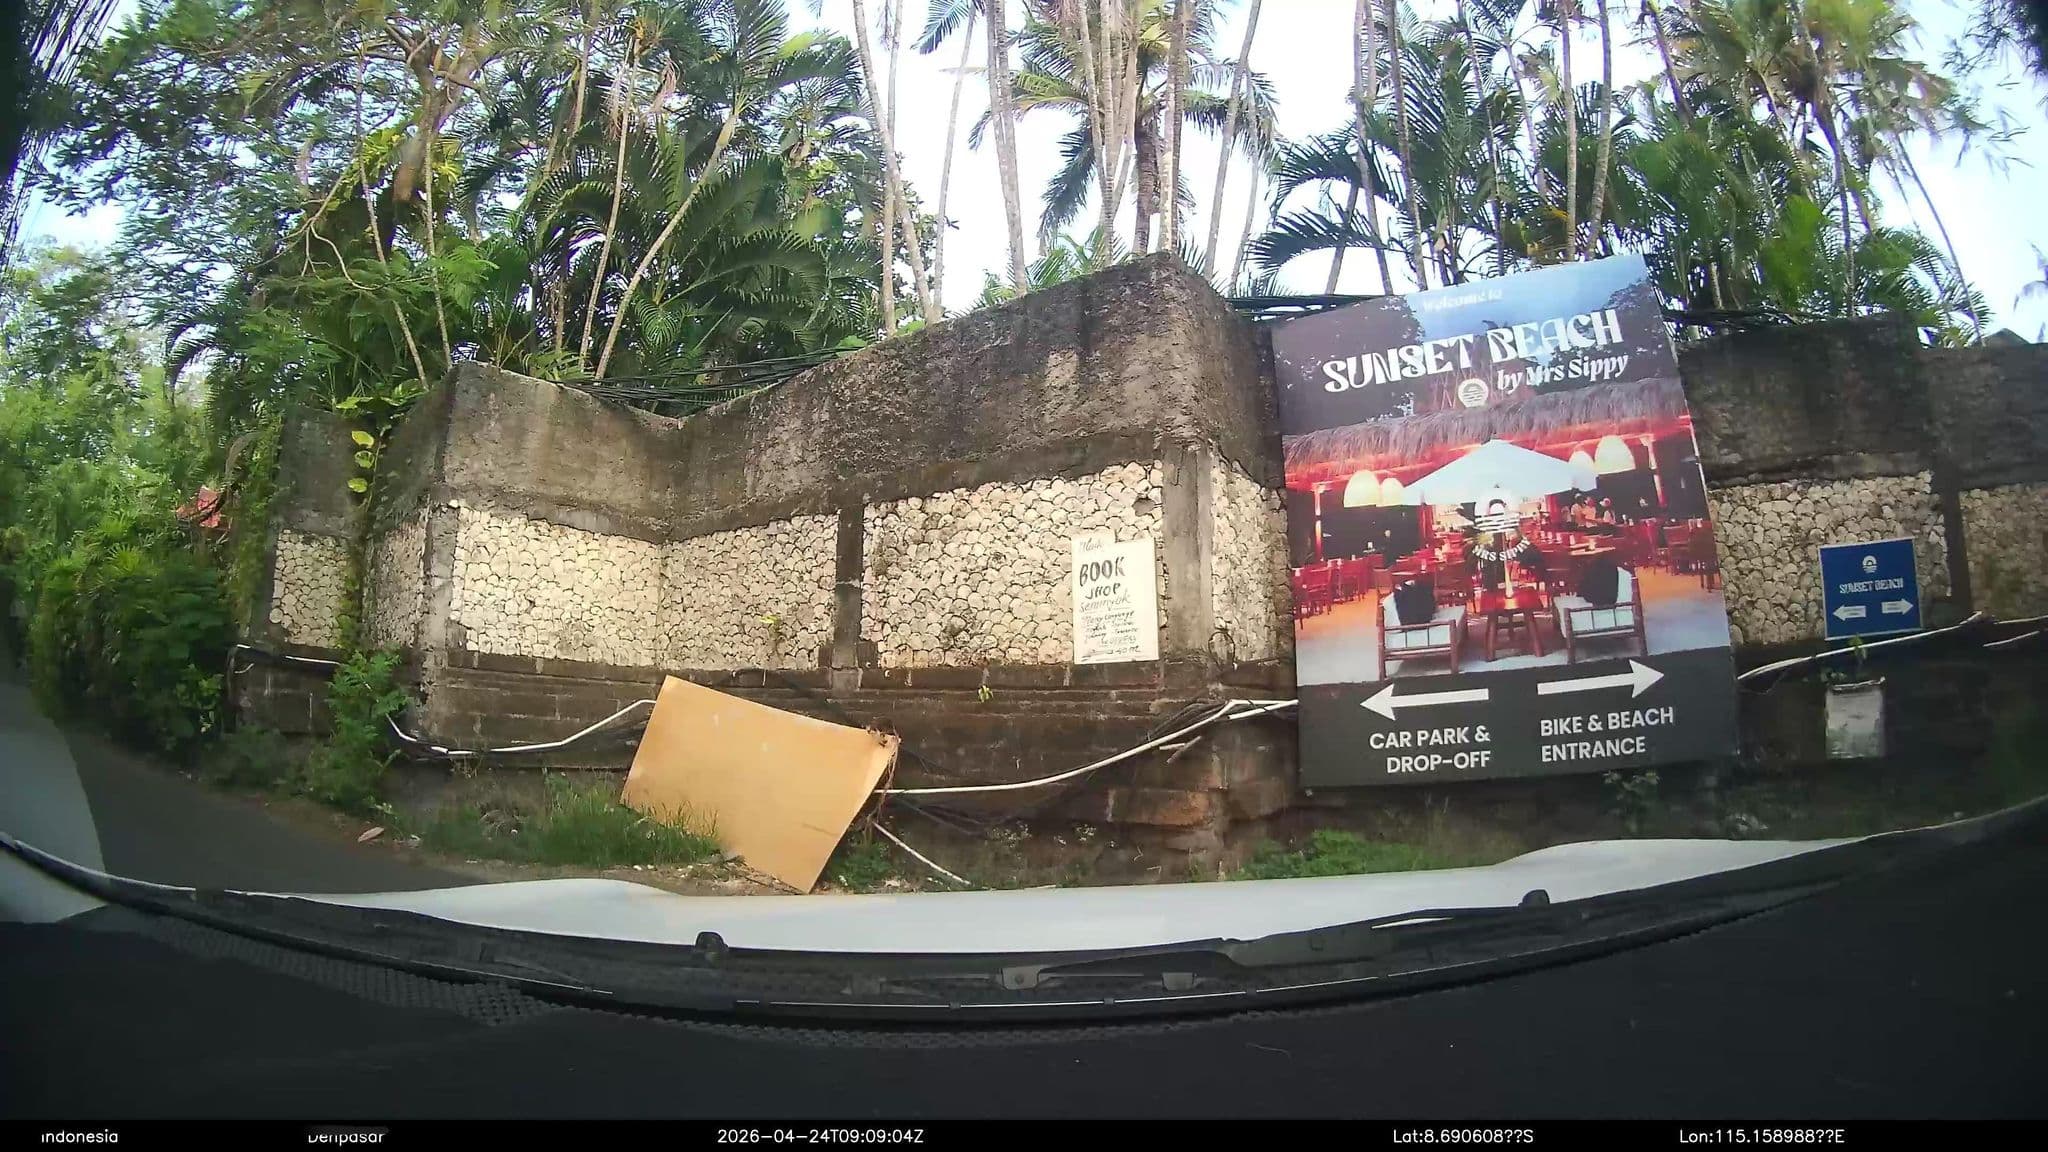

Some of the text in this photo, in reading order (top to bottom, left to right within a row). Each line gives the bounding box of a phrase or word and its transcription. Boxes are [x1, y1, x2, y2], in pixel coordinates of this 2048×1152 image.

[1322, 309, 1624, 393] SUNSET BEACH
[1497, 353, 1629, 394] by Mrs Sippy
[1472, 543, 1497, 561] MRS
[1079, 556, 1126, 587] BOOK
[1085, 582, 1121, 600] SHOP
[1839, 577, 1904, 594] SUNSET BEACH
[1540, 706, 1675, 737] BIKE & BEACH
[1369, 724, 1491, 750] CAR PARK &
[1541, 736, 1647, 762] ENTRANCE
[1386, 750, 1491, 774] DROP-OFF
